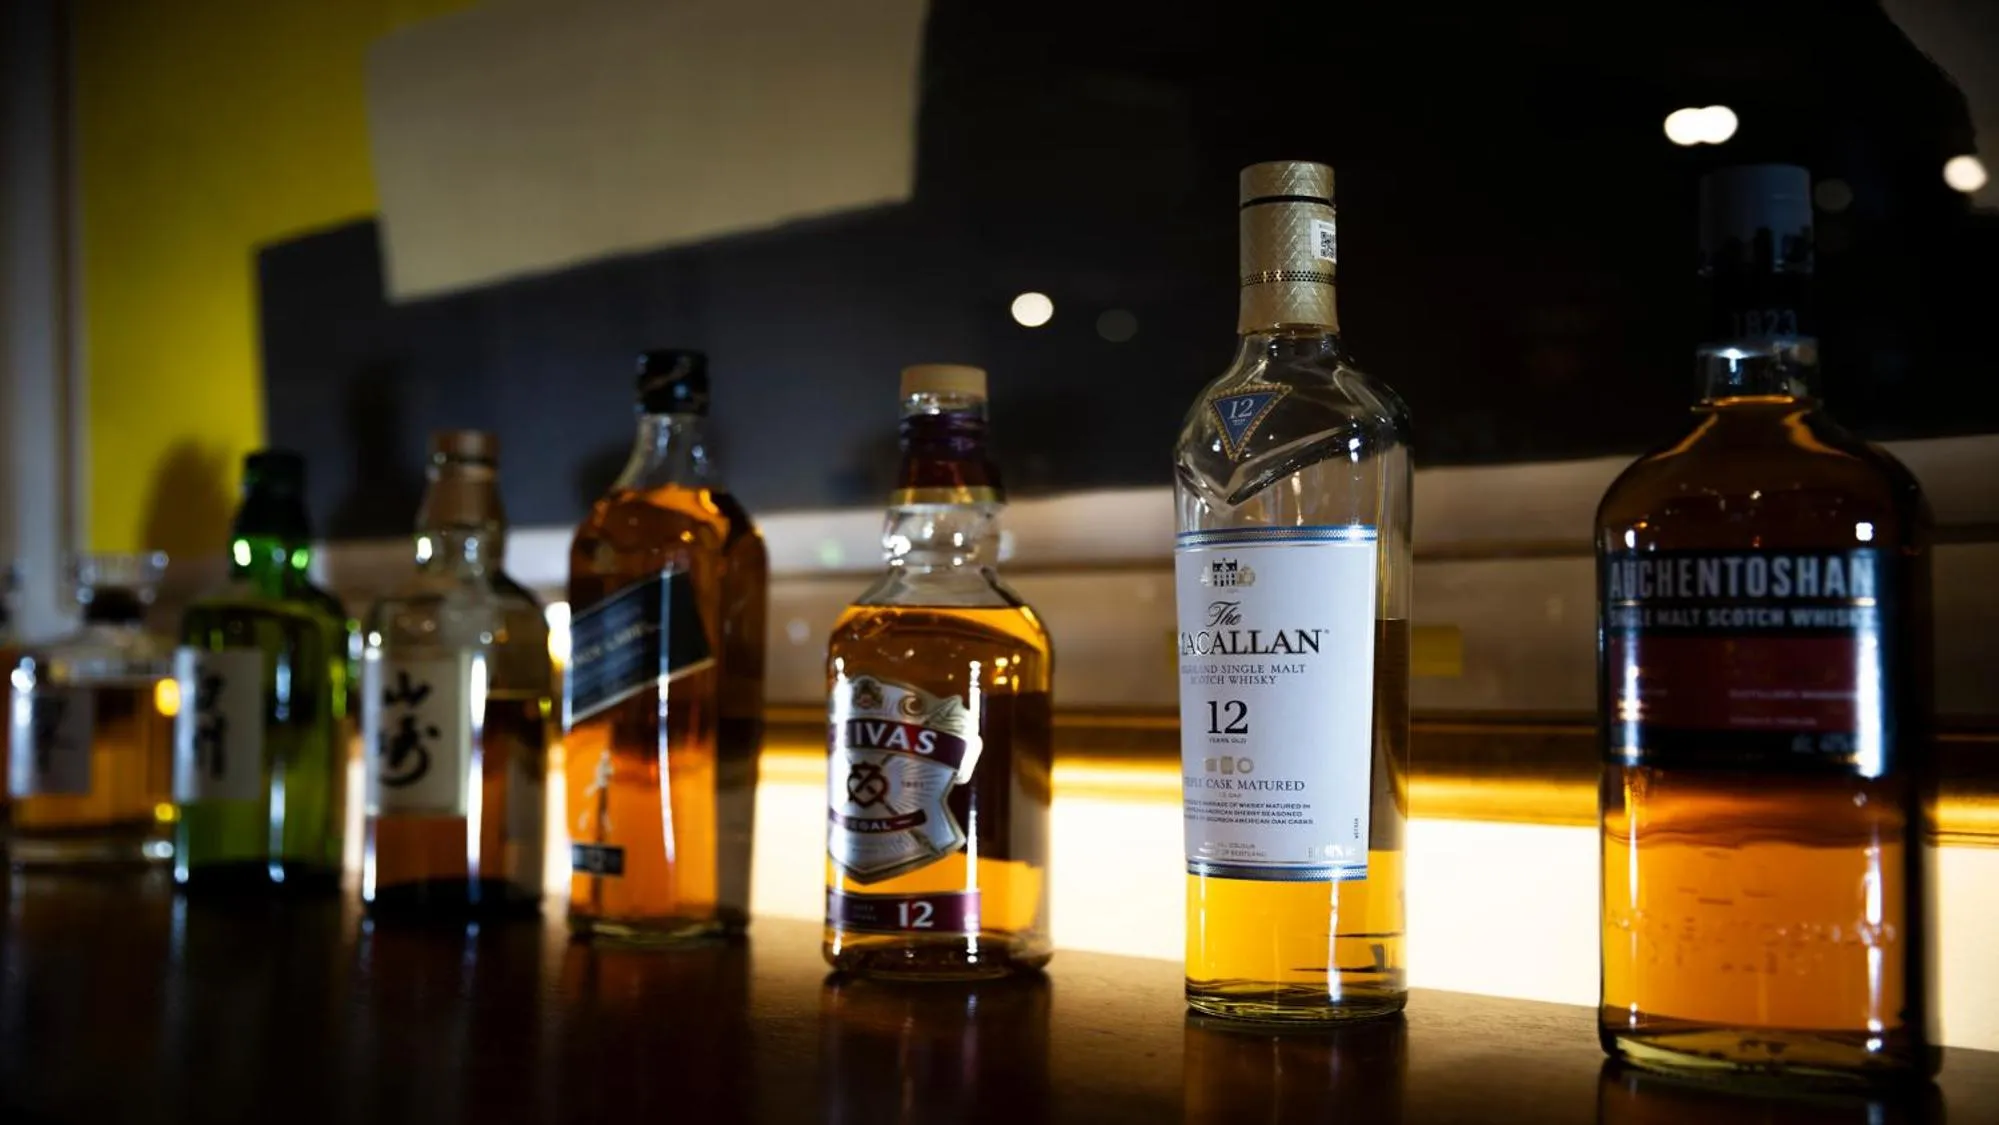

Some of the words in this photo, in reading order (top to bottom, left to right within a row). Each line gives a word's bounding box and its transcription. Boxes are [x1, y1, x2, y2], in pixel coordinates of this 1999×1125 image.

[1228, 398, 1255, 420] 12
[1610, 555, 1875, 599] AUCHENTOSHAN
[1206, 601, 1242, 628] The
[1706, 607, 1786, 627] SCOTCH
[1221, 663, 1265, 674] SINGLE
[1271, 663, 1307, 674] MALT
[1228, 675, 1278, 686] WHISKY
[1207, 699, 1249, 734] 12
[1206, 778, 1234, 791] CASK
[1237, 780, 1305, 792] MATURED
[850, 819, 893, 832] EGAL
[896, 900, 935, 929] 12
